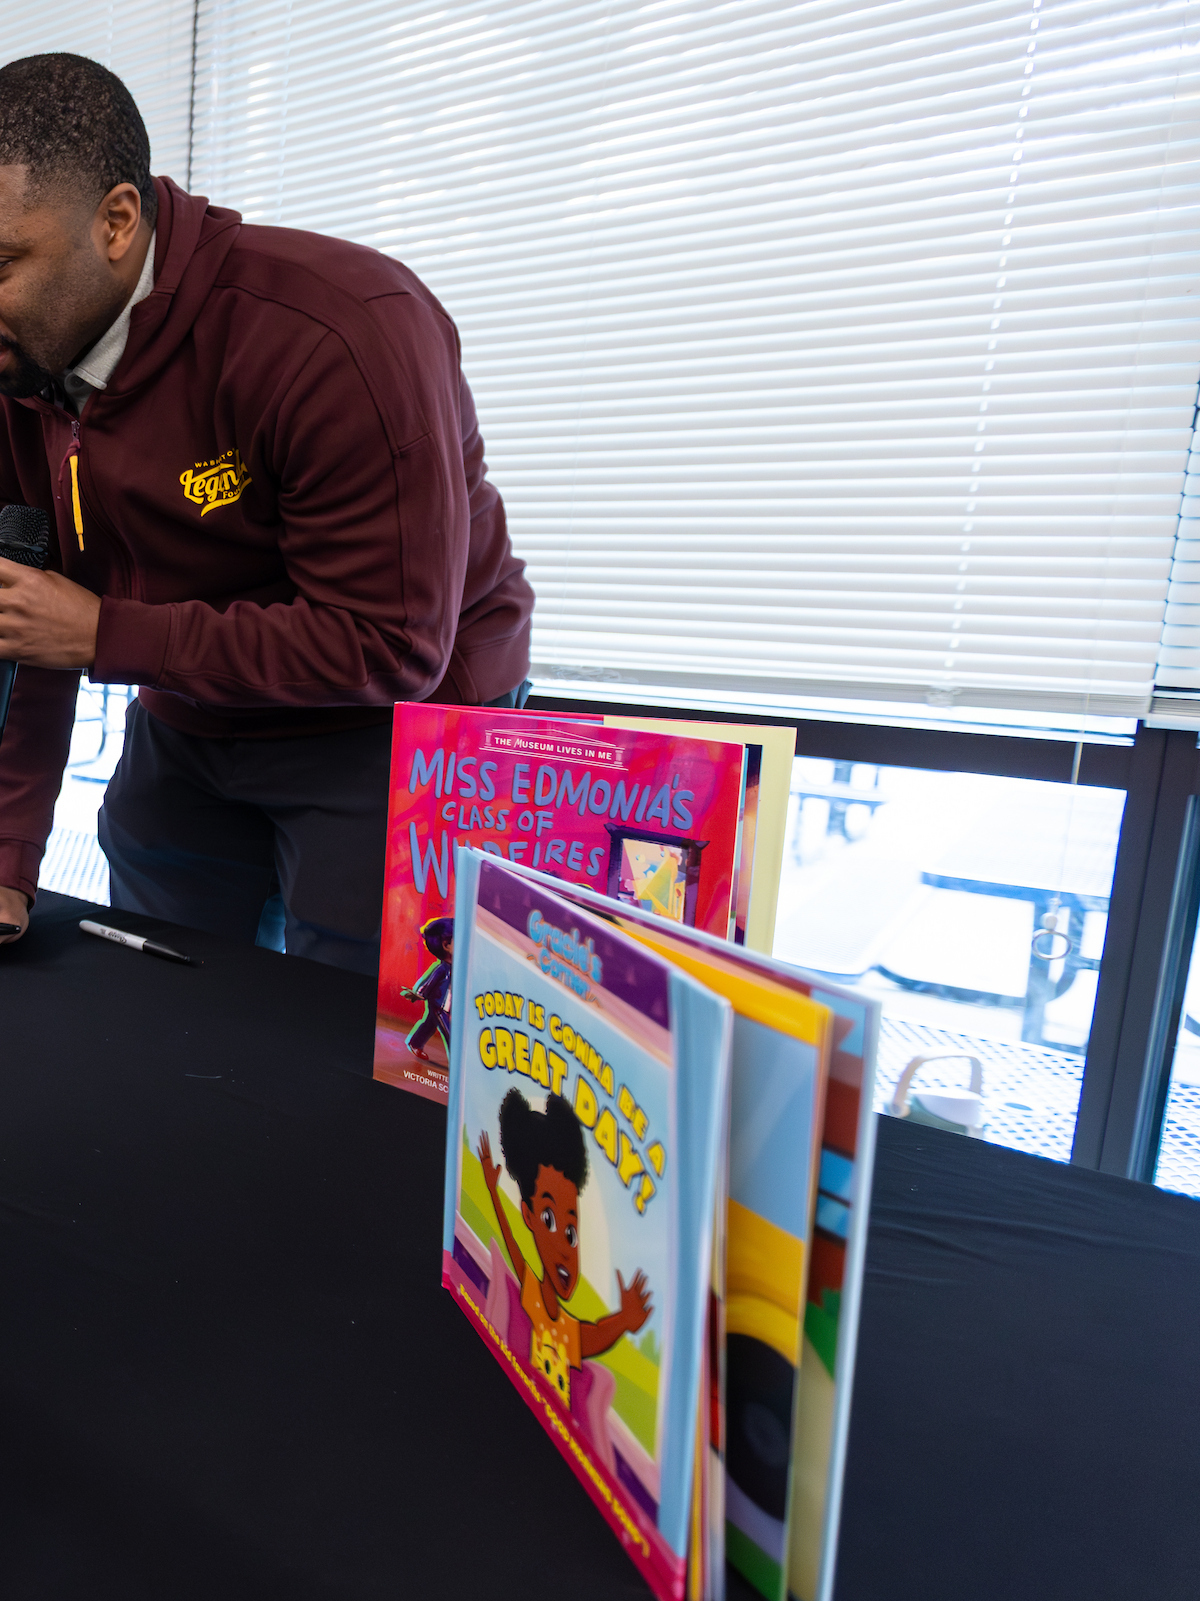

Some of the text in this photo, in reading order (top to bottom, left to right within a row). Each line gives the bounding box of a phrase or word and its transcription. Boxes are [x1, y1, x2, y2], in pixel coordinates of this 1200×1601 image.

[494, 737, 613, 760] THE MUSEUM LIVES IN ME
[408, 748, 695, 831] MISS EDMONIA'S
[441, 801, 554, 837] CLASS OF
[403, 1069, 438, 1089] VICTORIA
[474, 990, 666, 1179] TODAY IS GONNA BE A
[478, 1026, 656, 1216] GREAT DAY!
